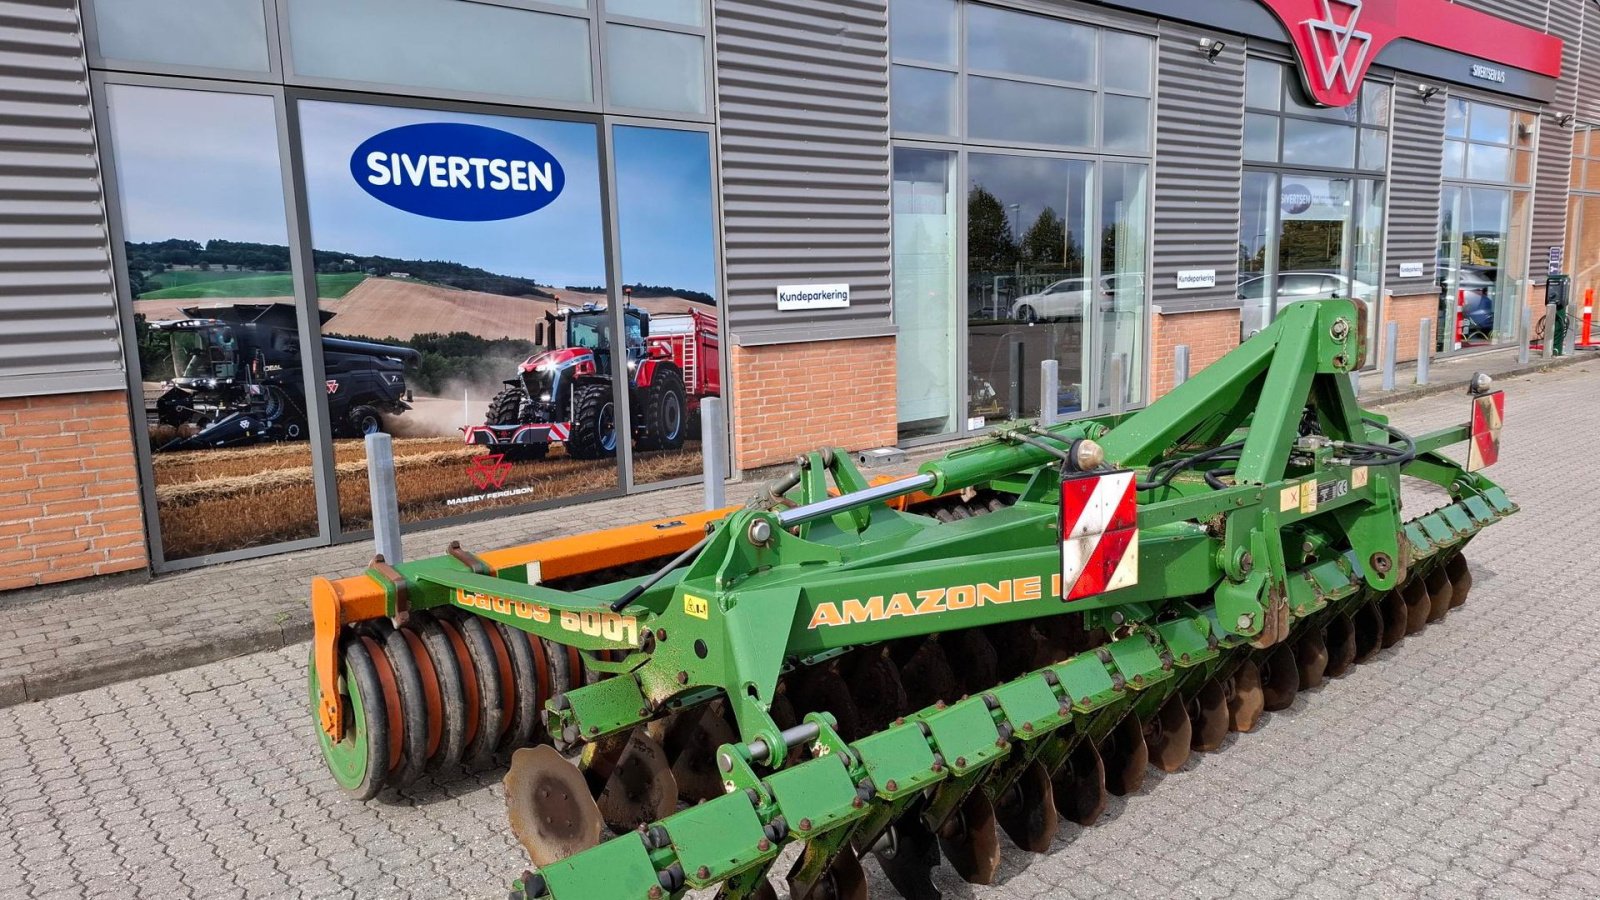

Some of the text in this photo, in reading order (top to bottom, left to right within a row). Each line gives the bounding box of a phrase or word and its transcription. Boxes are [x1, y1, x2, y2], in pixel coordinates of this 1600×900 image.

[366, 151, 553, 192] SIVERTSEN
[779, 289, 848, 303] Kundeparkering
[447, 487, 534, 505] MASSEY FERGUSON
[457, 587, 551, 624] Catros
[807, 575, 1042, 629] AMAZONE
